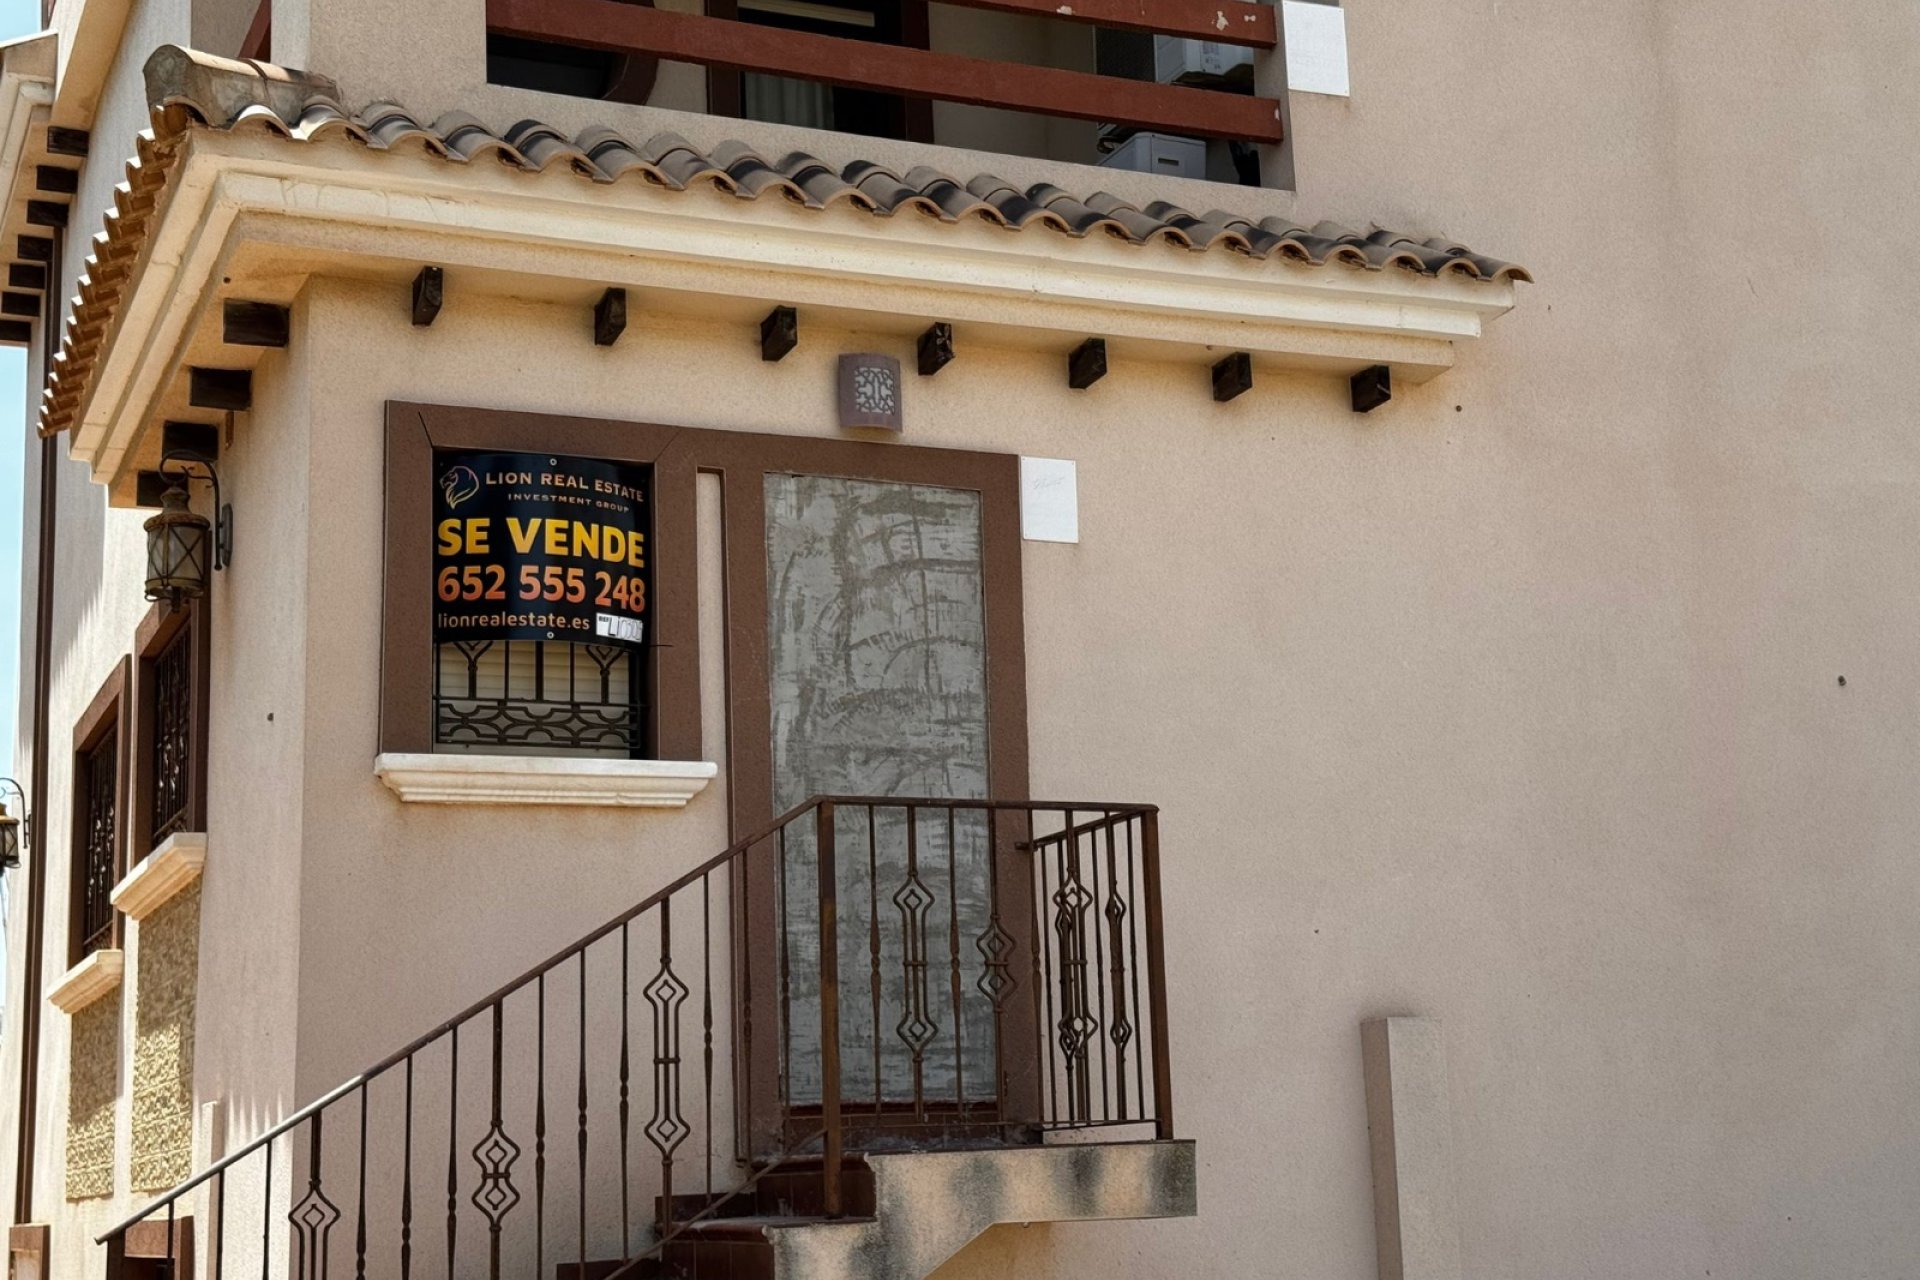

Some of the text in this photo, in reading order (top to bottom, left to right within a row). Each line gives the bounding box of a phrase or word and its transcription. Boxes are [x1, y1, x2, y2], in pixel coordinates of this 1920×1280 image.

[486, 472, 644, 502] LION REAL ESTATE
[508, 493, 630, 513] INVESTMENT GROUP
[438, 517, 645, 568] SE VENDE
[438, 564, 645, 613] 652 555 248
[438, 611, 590, 630] lionrealestate.es
